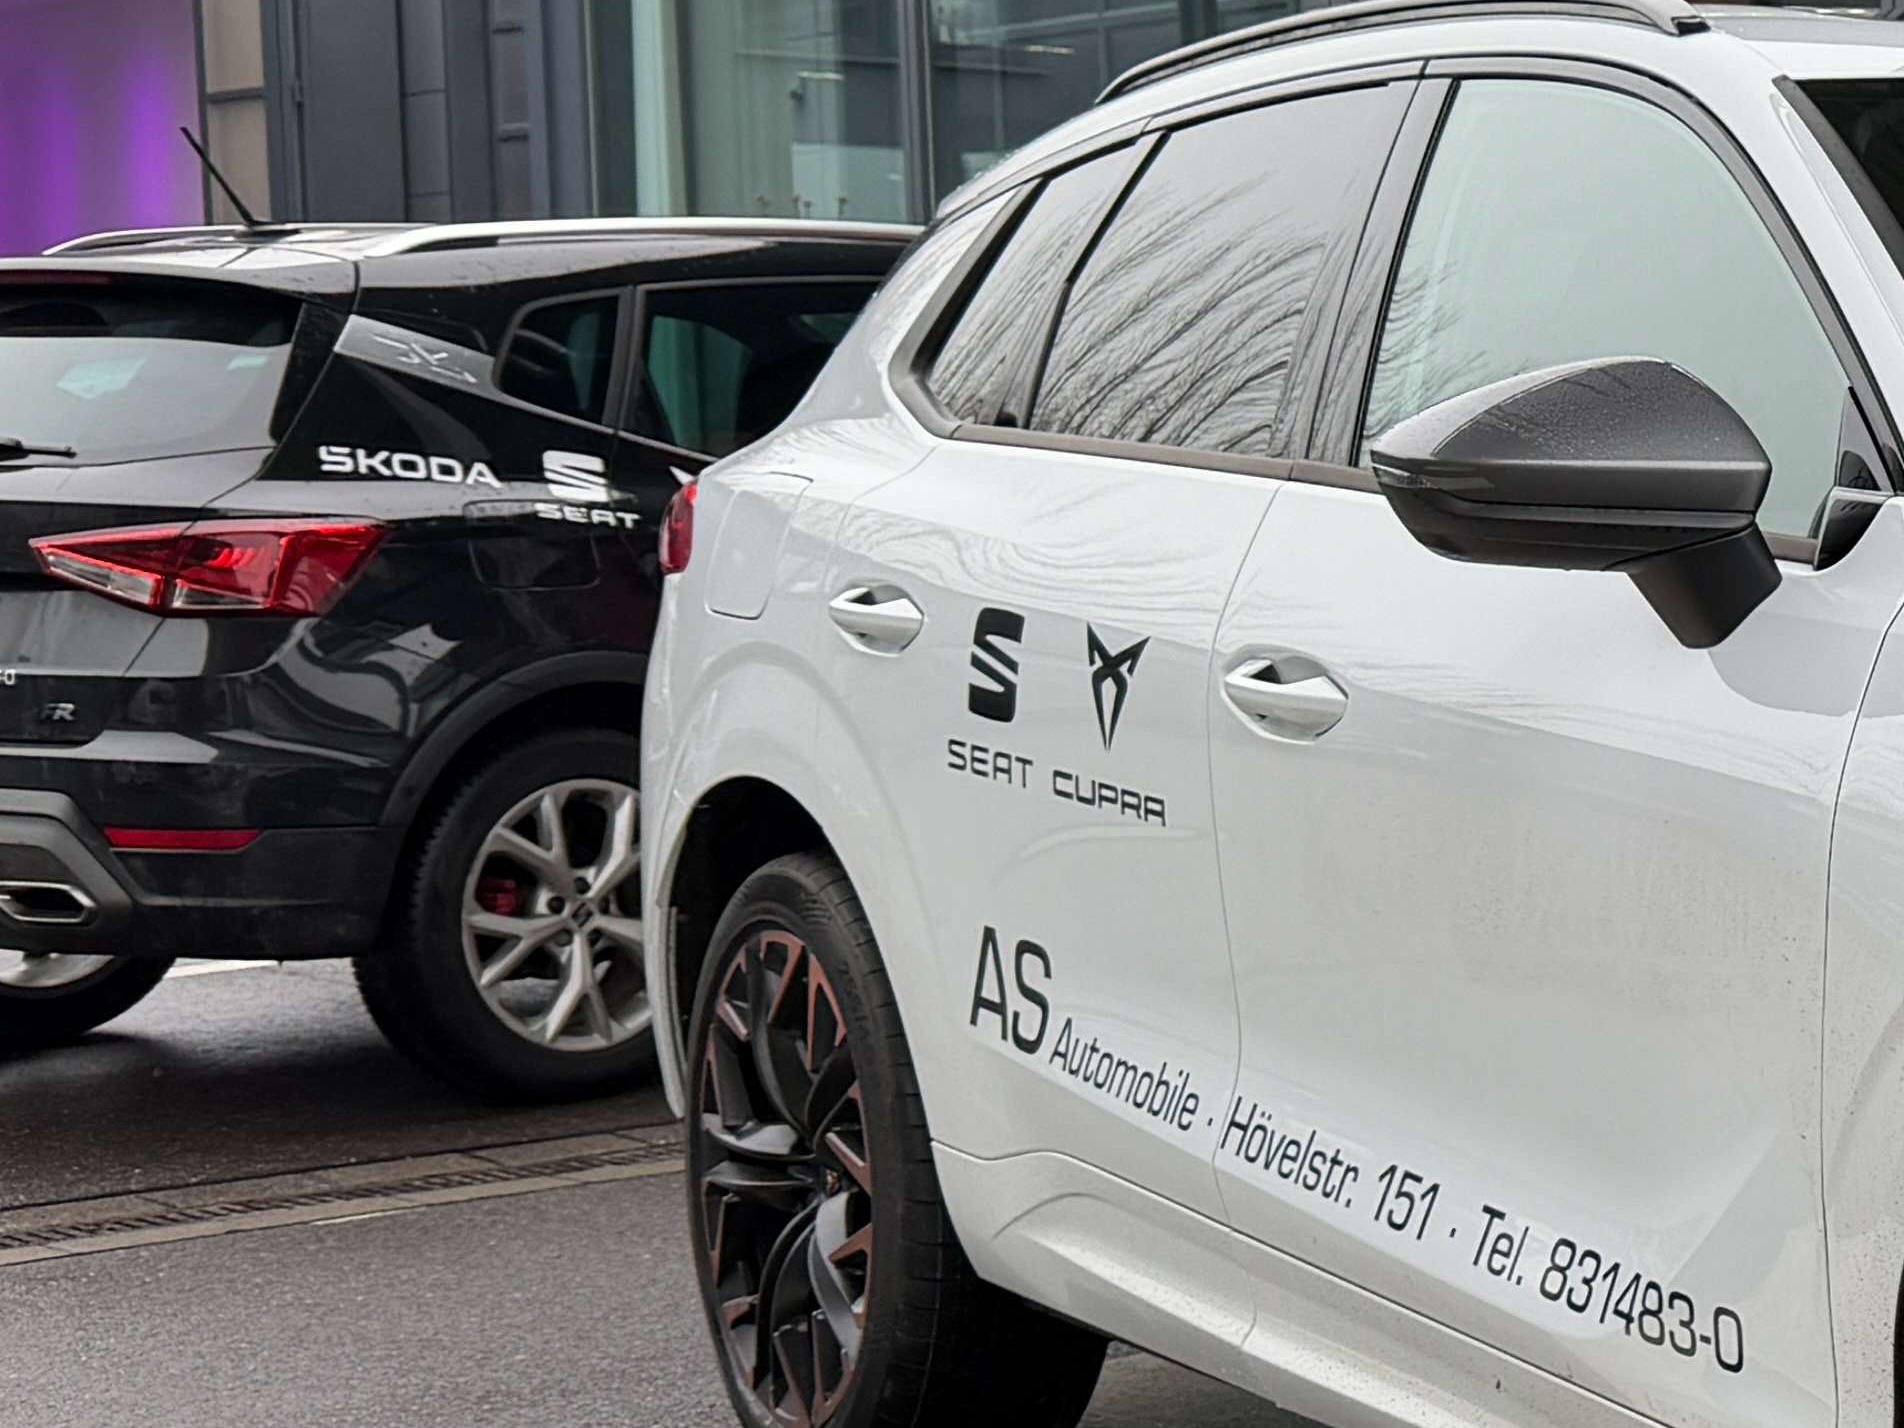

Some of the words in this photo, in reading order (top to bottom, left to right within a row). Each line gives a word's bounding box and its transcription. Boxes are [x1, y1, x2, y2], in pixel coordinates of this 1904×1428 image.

[533, 501, 641, 529] SEAT
[947, 738, 1034, 789] SEAT
[1052, 769, 1167, 828] CUPRA
[968, 924, 1053, 1056] AS
[1048, 1016, 1201, 1132] Automobile
[1220, 1095, 1359, 1209] Hövelstr.
[1371, 1163, 1441, 1241] 151
[1471, 1204, 1524, 1288] Tel.
[1538, 1237, 1745, 1374] 831483-0
